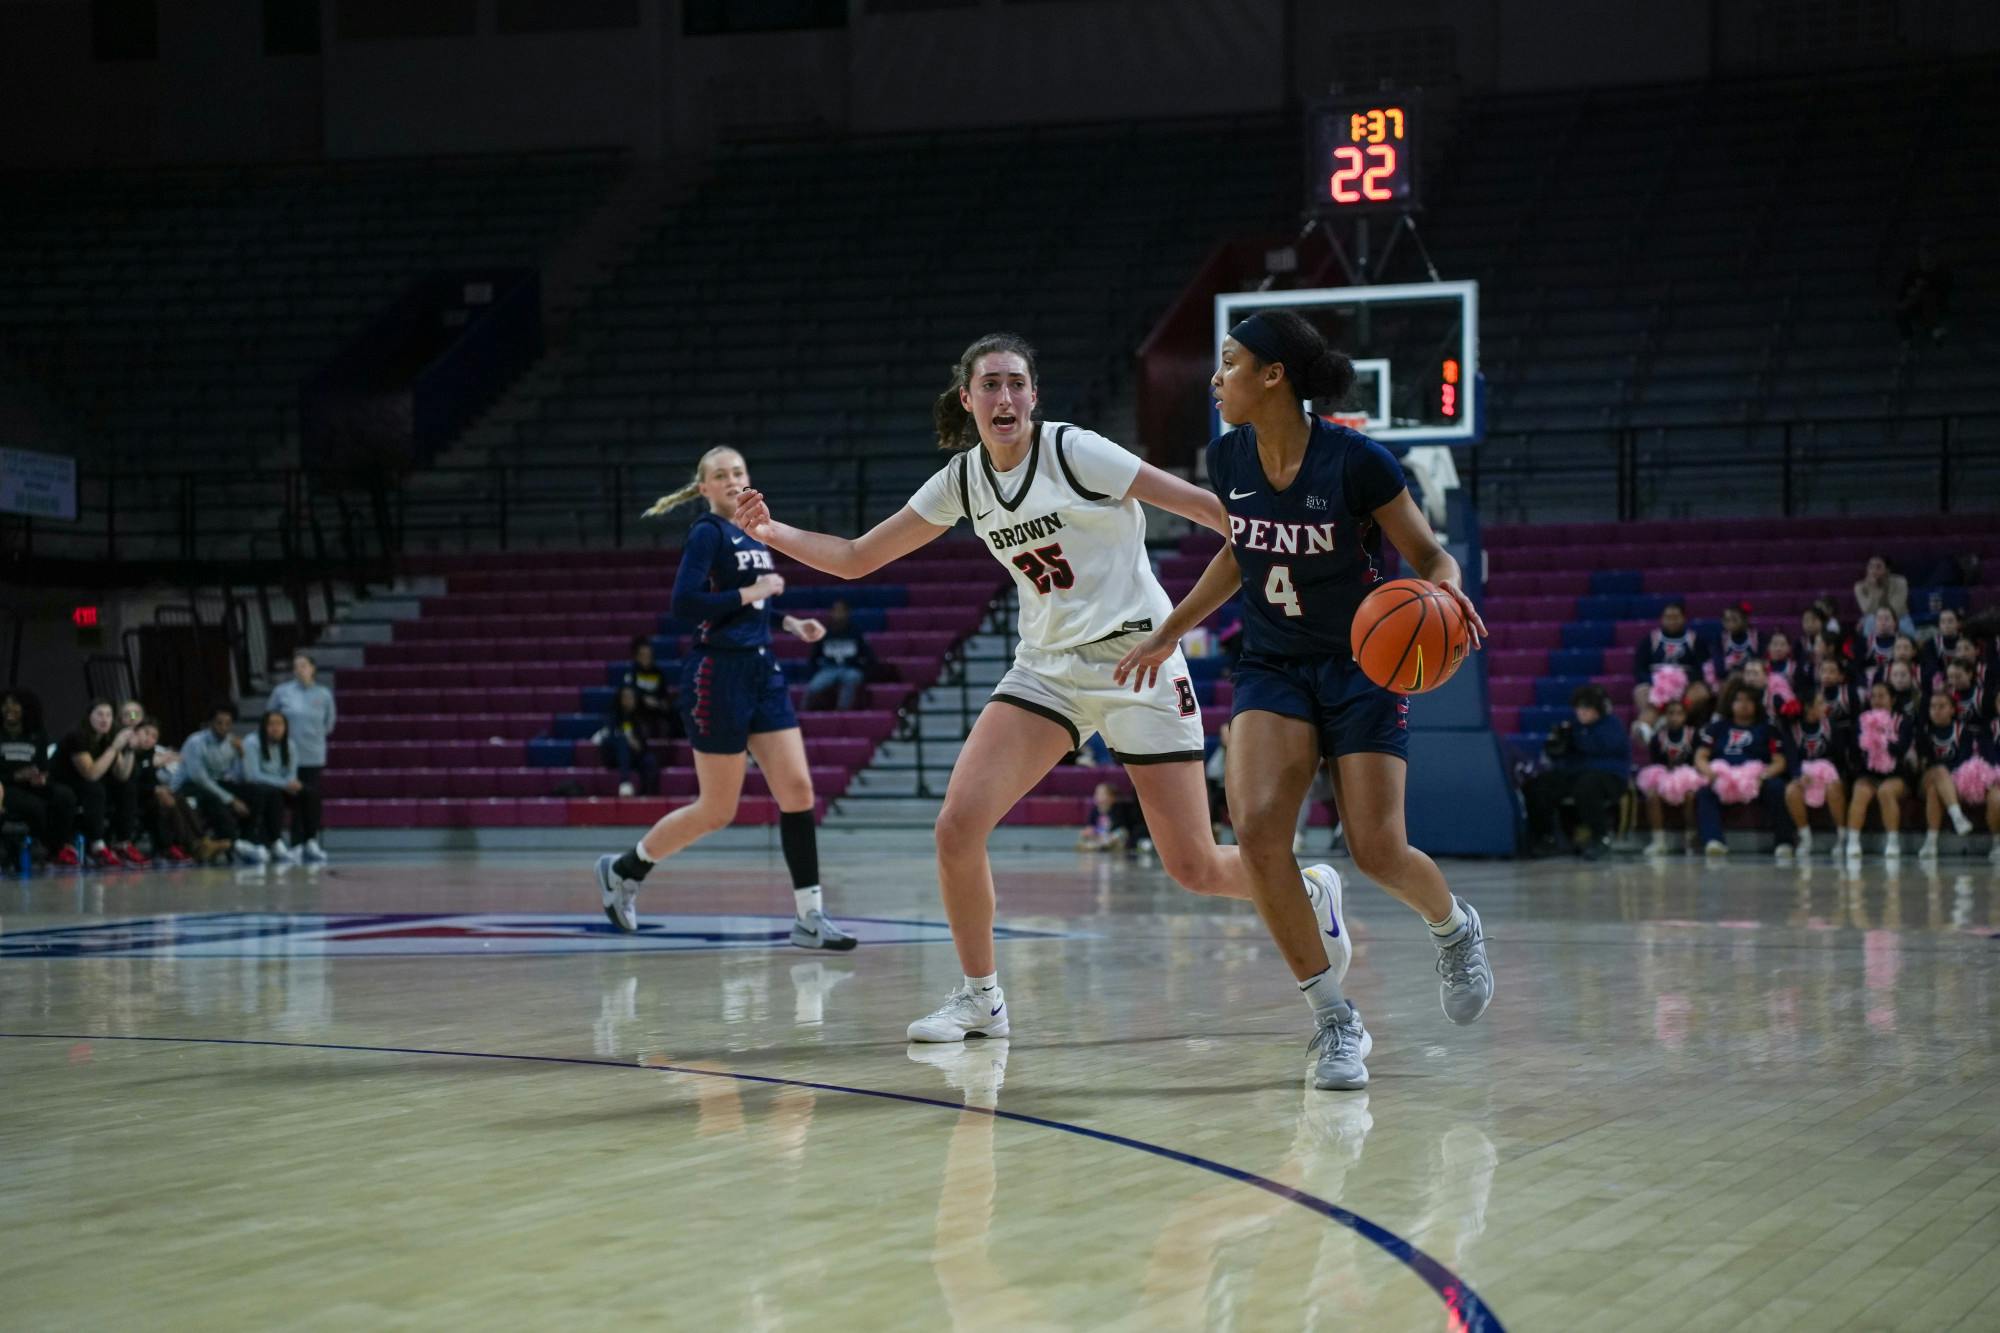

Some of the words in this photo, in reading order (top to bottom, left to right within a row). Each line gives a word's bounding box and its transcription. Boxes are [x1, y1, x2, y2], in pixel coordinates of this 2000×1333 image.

[1351, 108, 1404, 143] 1:37
[1331, 145, 1396, 203] 22
[989, 511, 1063, 549] BROWN
[1228, 514, 1336, 555] PENN
[734, 549, 775, 571] PEN
[1012, 542, 1075, 595] 25
[1263, 564, 1303, 617] 4
[1173, 677, 1197, 717] B
